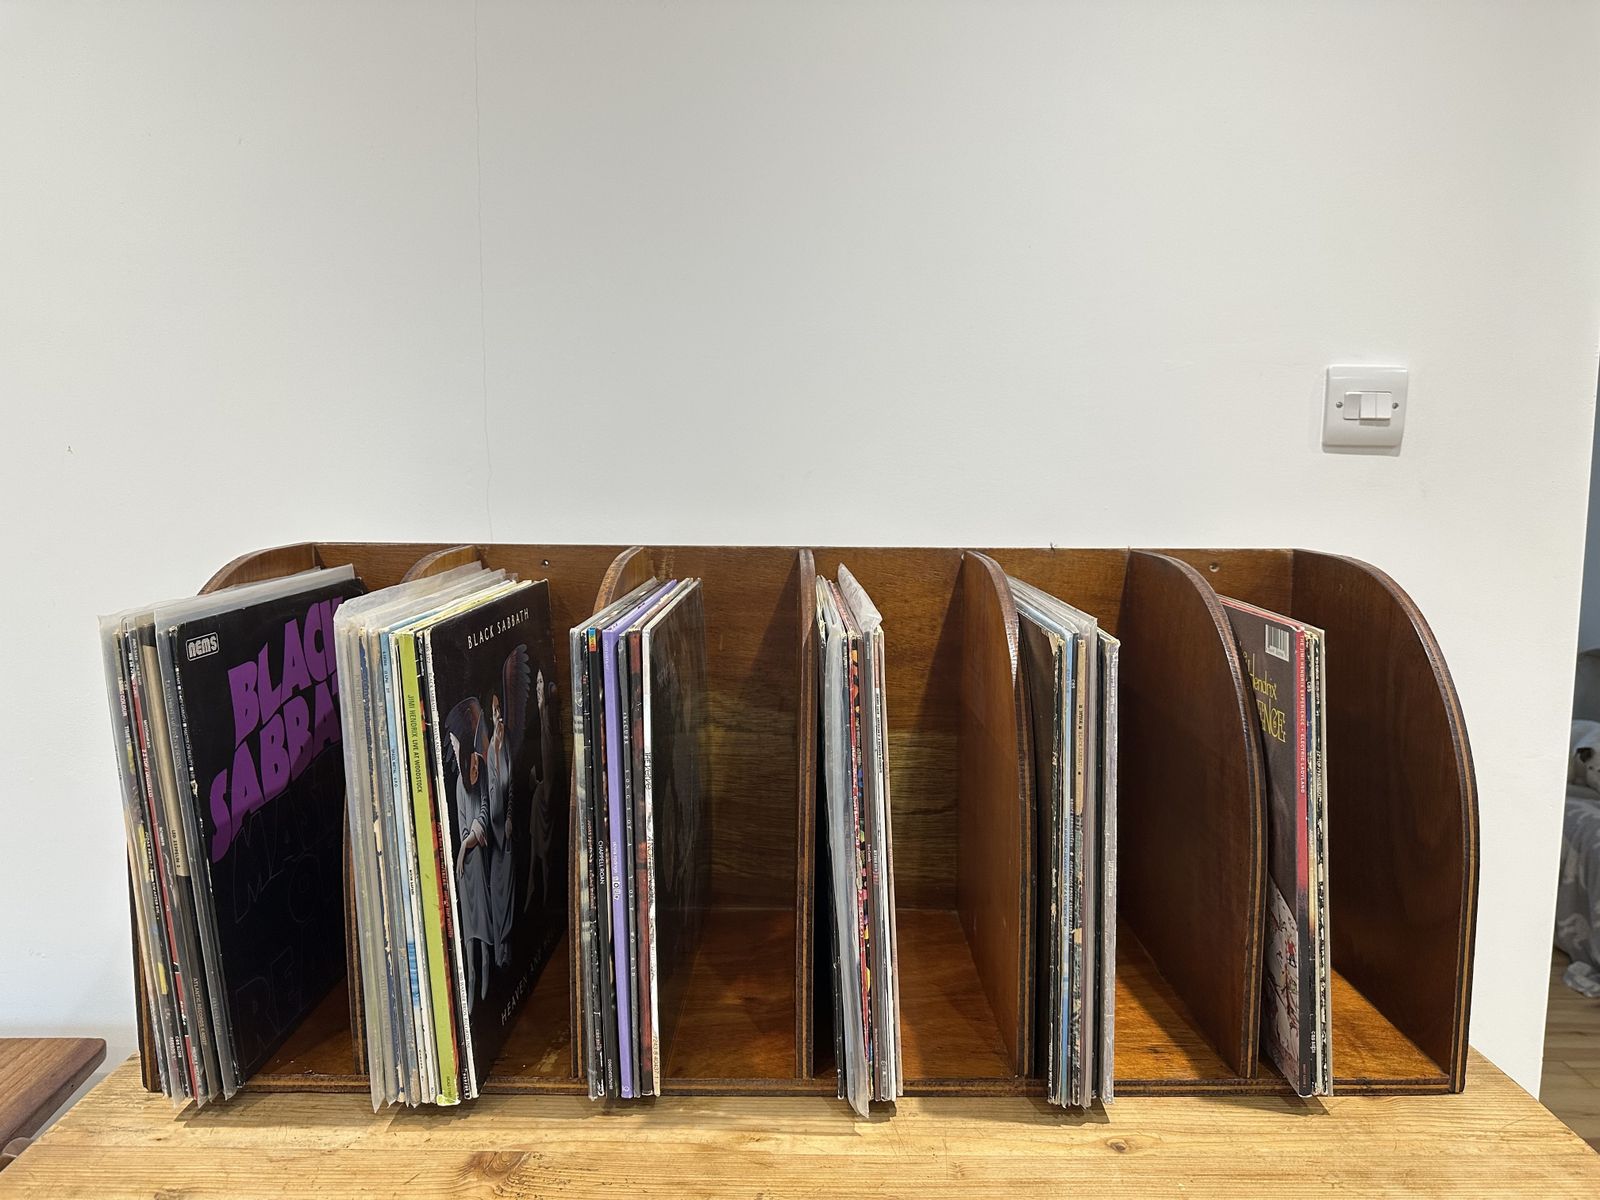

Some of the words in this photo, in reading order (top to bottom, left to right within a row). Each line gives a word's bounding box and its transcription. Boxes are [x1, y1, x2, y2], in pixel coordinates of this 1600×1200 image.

[468, 624, 494, 650] BLACK
[497, 608, 530, 634] SABBATH
[188, 636, 217, 658] NEMS
[227, 596, 343, 750] BLACK
[119, 694, 127, 716] COLOUR
[407, 694, 415, 708] JIMI
[408, 709, 418, 737] HENDRIX
[411, 738, 419, 750] LIVE
[208, 677, 342, 861] SABBA
[414, 759, 423, 792] WOODSTOCK
[172, 840, 180, 862] ZEPPELIN
[192, 977, 201, 1002] ATLANTIC
[195, 1003, 204, 1026] RECORDS
